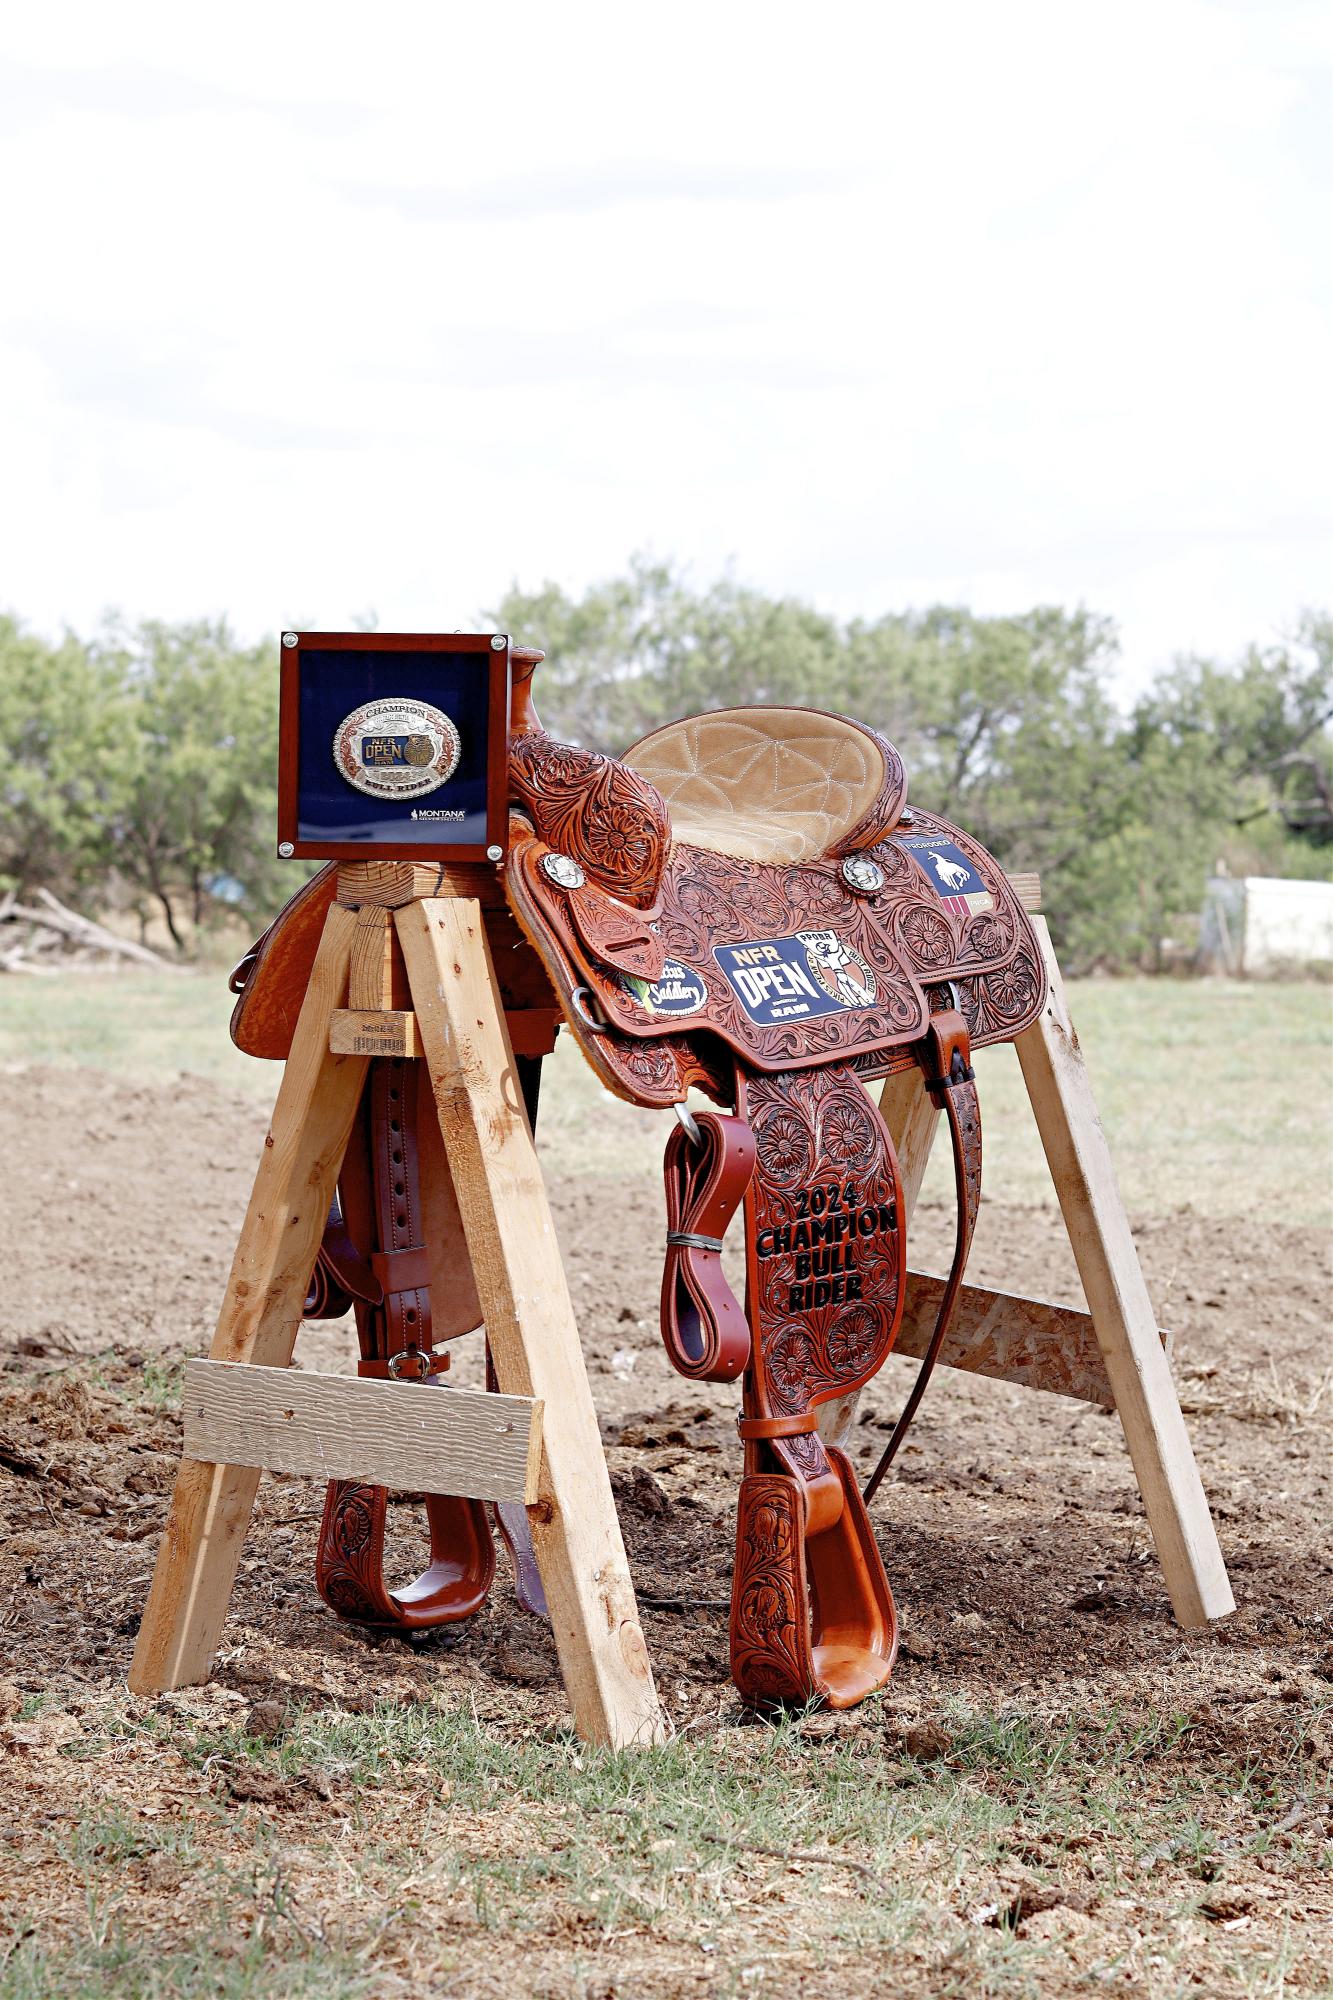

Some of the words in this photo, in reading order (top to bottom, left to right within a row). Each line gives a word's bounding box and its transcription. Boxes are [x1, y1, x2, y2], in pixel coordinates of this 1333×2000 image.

[366, 705, 425, 718] CHAMPION
[365, 745, 402, 758] OPEN
[365, 780, 393, 791] BULL
[397, 778, 432, 791] RIDER
[905, 840, 951, 850] PRORODEO
[730, 945, 781, 967] NFR
[811, 966, 825, 985] PEAK
[848, 951, 865, 967] BUST
[863, 968, 876, 994] RODEO
[650, 981, 701, 1005] Saddlery
[732, 960, 820, 1008] OPEN
[825, 985, 845, 1003] PIKES
[770, 1003, 810, 1018] RAM
[797, 1181, 857, 1219] 2024
[756, 1204, 897, 1258] CHAMPION
[795, 1244, 857, 1281] BULL
[789, 1275, 863, 1313] RIDER
